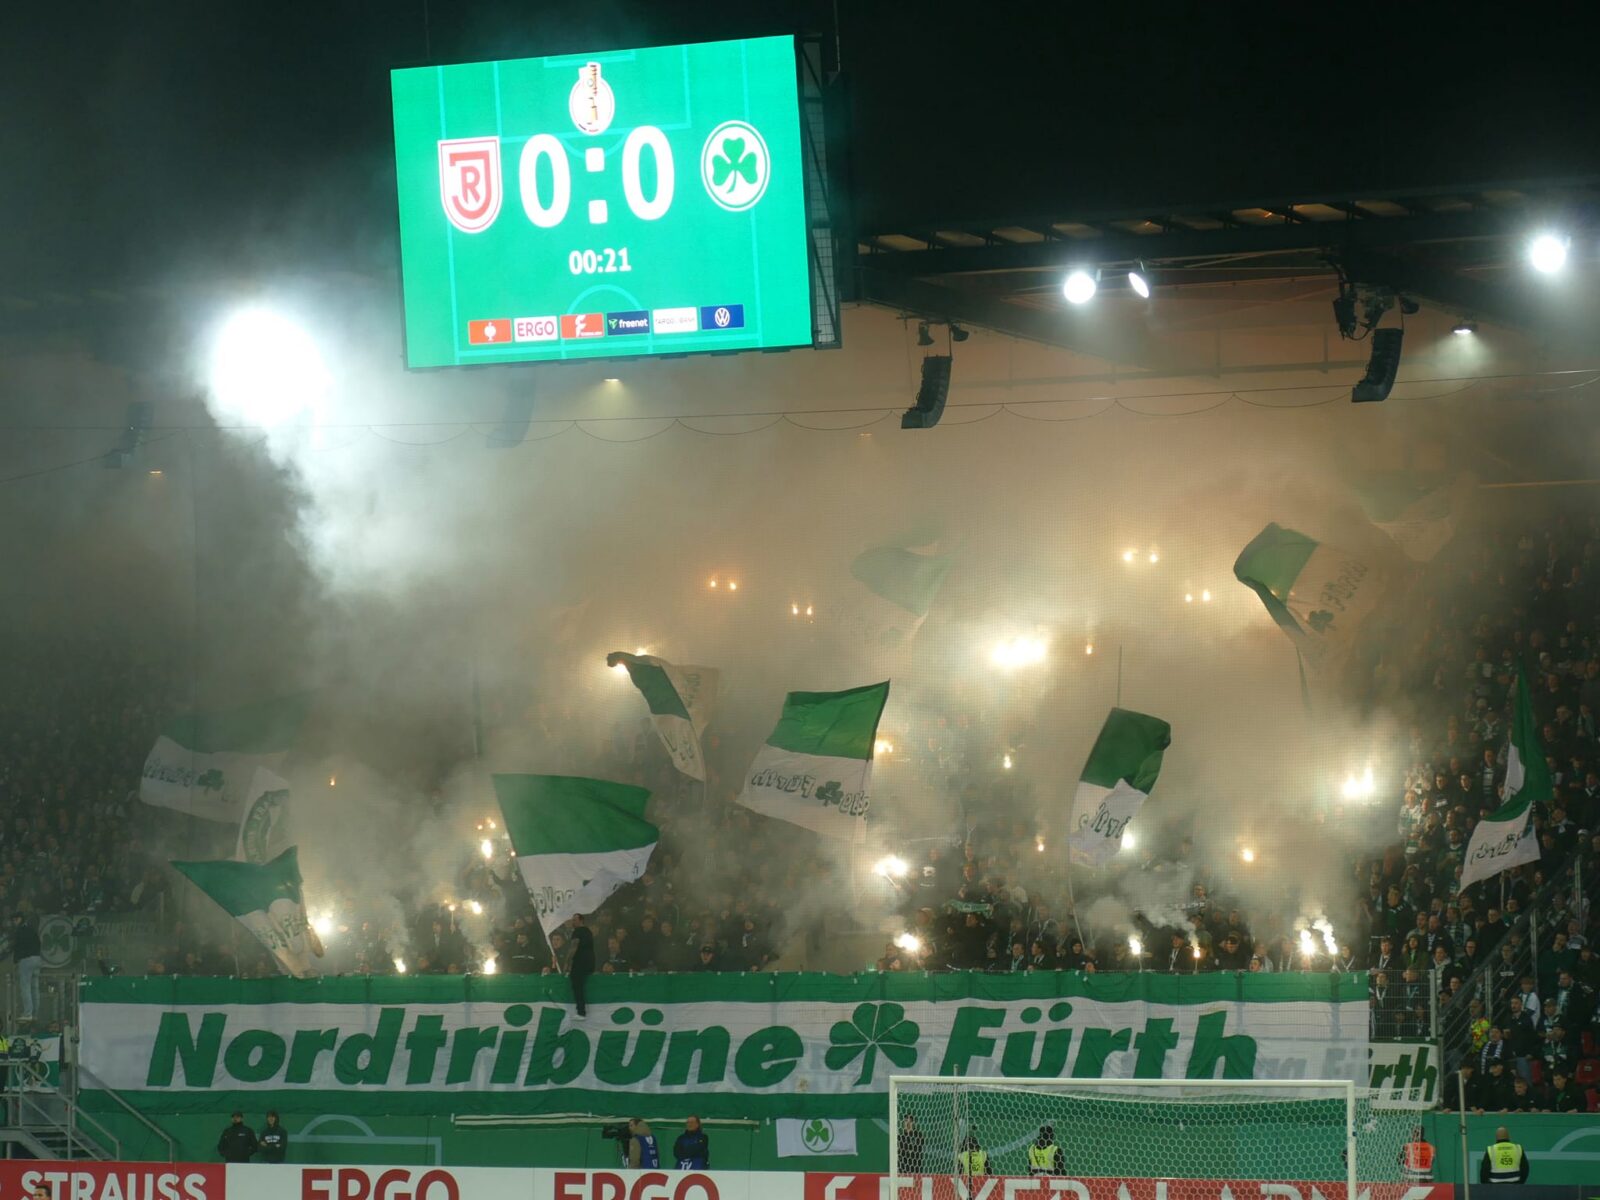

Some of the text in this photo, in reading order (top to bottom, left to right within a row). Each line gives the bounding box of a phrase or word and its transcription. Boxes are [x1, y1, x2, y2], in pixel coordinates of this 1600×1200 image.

[569, 247, 632, 275] 00:21
[517, 320, 555, 337] ERGO
[618, 317, 649, 329] freenet
[146, 1004, 804, 1088] Nordtribüne
[939, 1001, 1257, 1079] Fürth
